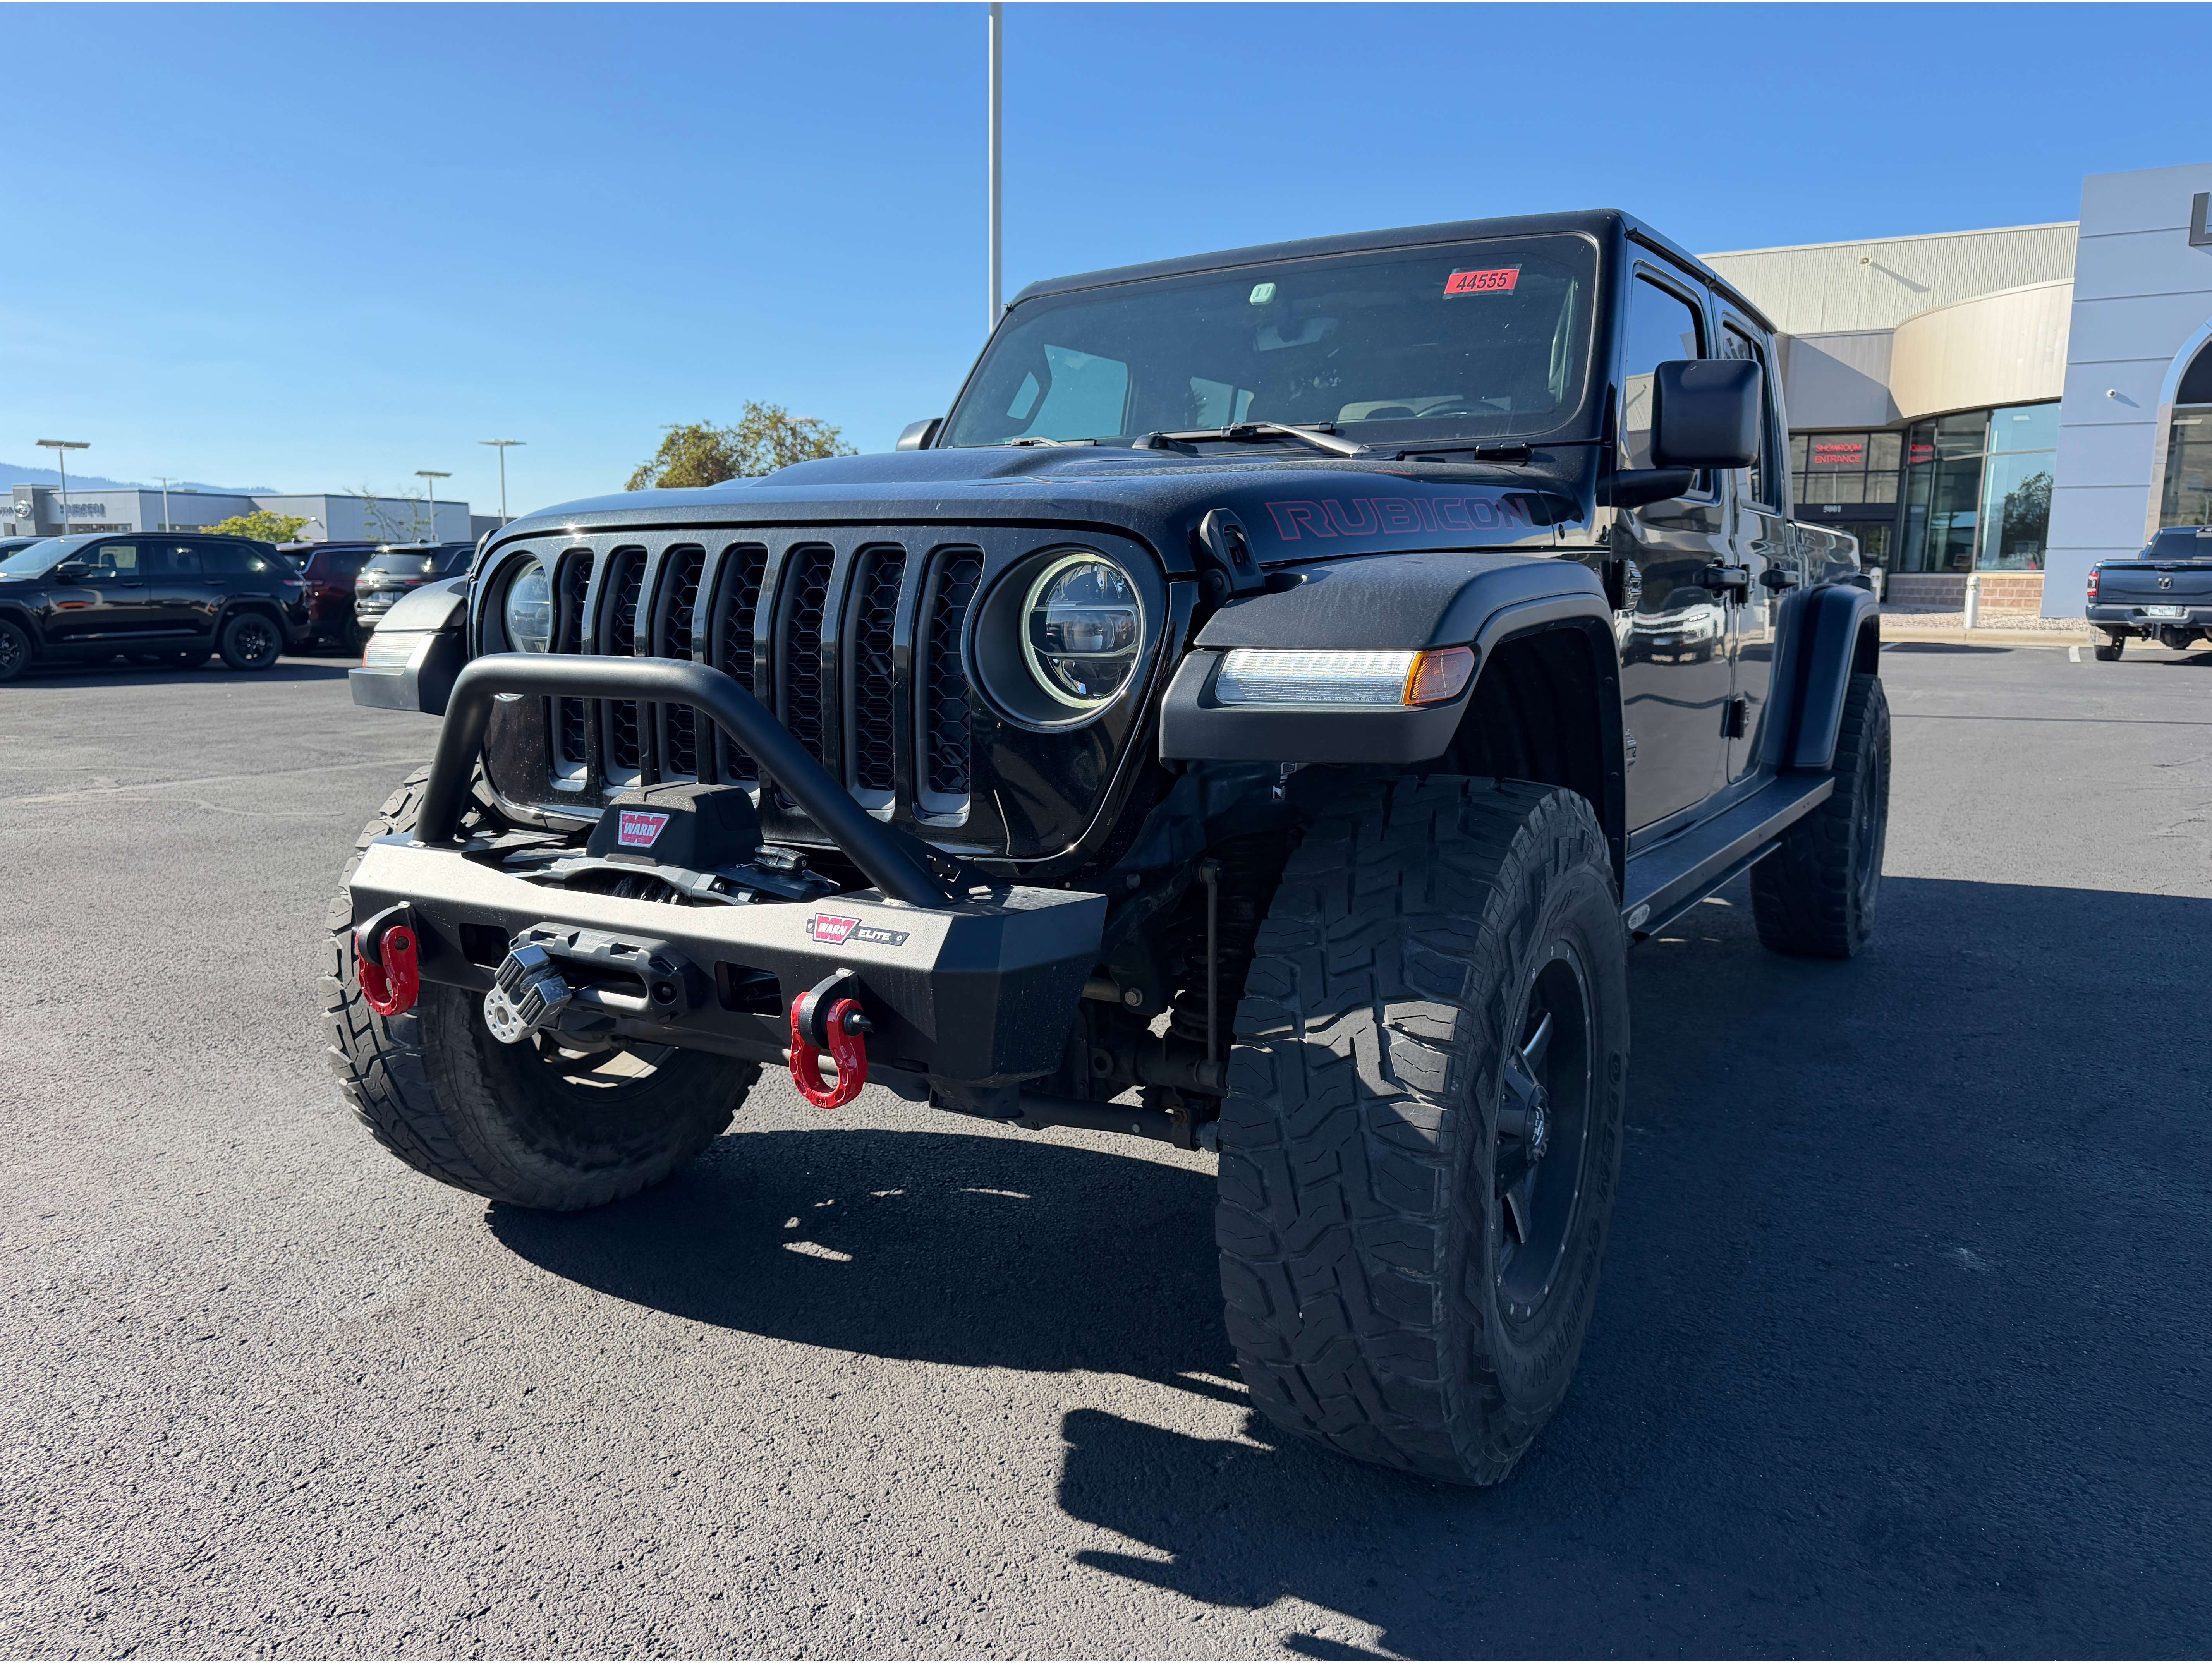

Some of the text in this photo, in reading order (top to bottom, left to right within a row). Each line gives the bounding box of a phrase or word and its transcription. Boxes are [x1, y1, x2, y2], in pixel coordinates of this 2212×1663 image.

[1456, 273, 1508, 290] 44555
[1815, 443, 1863, 453] SHOWROOM
[1815, 454, 1862, 463] ENTRANCE
[1265, 498, 1534, 541] RUBICON
[623, 822, 656, 836] WARN
[817, 922, 892, 941] WARN ELITE
[1597, 1050, 1621, 1204] OPEN
